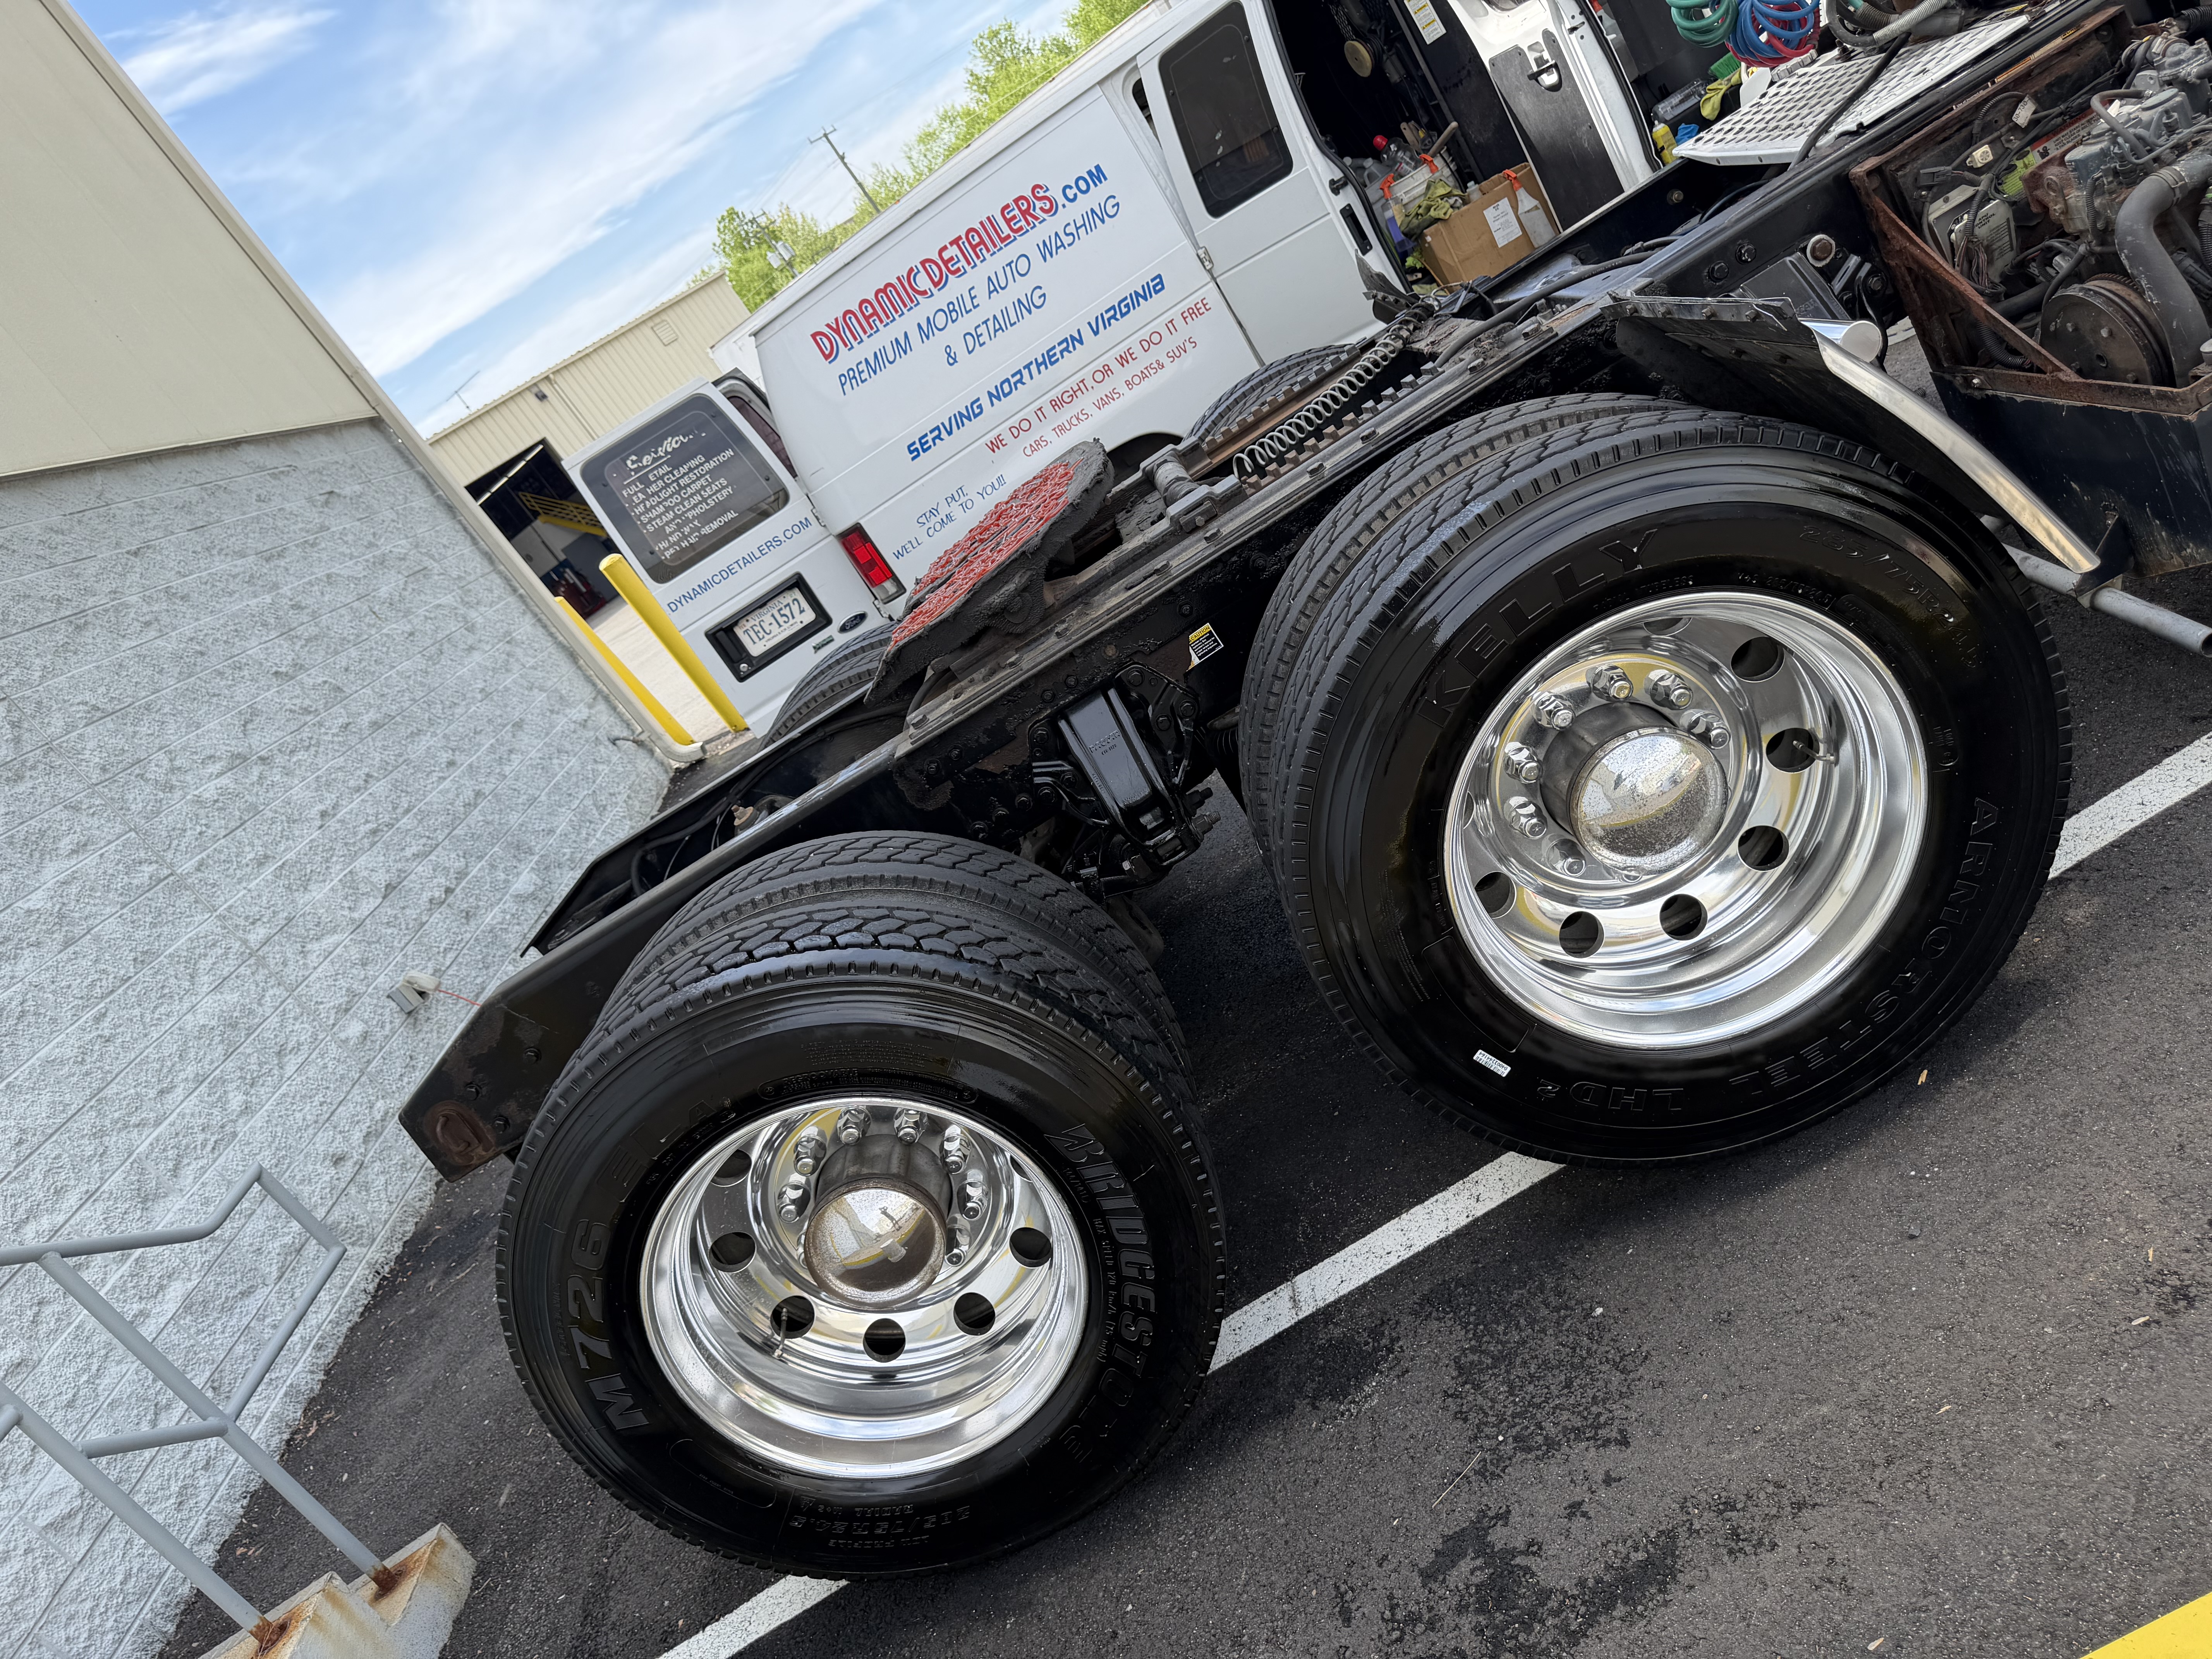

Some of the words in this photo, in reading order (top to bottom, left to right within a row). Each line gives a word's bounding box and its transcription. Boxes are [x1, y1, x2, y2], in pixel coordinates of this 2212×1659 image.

[1975, 213, 1996, 227] ONTROL
[1978, 213, 1988, 222] APU
[1978, 220, 1990, 229] UNIT
[810, 164, 1108, 364] DYNAMICDETAILERS.COM
[838, 331, 913, 396] PREMIUM
[917, 286, 980, 344] MOBILE
[986, 254, 1031, 299] AUTO
[1036, 195, 1120, 263] WASHING
[945, 345, 957, 367] &
[963, 285, 1046, 354] DETAILING
[907, 397, 984, 462] SERVING
[987, 328, 1084, 407] NORTHERN
[1087, 273, 1165, 337] VIRGINIA
[985, 433, 1007, 453] WE
[1009, 418, 1031, 439] DO
[1034, 406, 1050, 423] IT
[1115, 347, 1138, 368] WE
[1139, 331, 1162, 353] DO
[1165, 318, 1178, 336] IT
[1180, 297, 1212, 326] FREE
[1022, 435, 1053, 457] CARS,
[1052, 409, 1093, 438] TRUCKS,
[1092, 387, 1124, 411] VANS,
[1166, 336, 1197, 363] SUV'S
[622, 482, 644, 497] FULL
[647, 464, 672, 481] ETAIL
[634, 481, 665, 505] EAHER
[664, 455, 705, 483] CLEANING
[680, 448, 734, 487] RESTORATION
[680, 474, 712, 497] CARPET
[646, 511, 674, 532] STEAM
[674, 495, 702, 514] CLEAN
[701, 478, 727, 498] SEATS
[682, 486, 733, 520] PHOLSTERY
[701, 510, 739, 536] REMOVAL
[893, 536, 923, 560] WE'LL
[927, 511, 957, 537] COME
[958, 498, 974, 513] TO
[976, 474, 1006, 500] YOU!!
[917, 502, 940, 528] STAY
[945, 485, 968, 507] PUT,
[667, 517, 812, 613] DYNAMICDETAILERS.COM
[743, 598, 805, 645] TEC-1572
[750, 600, 783, 622] VIRGINIA
[1191, 626, 1210, 640] CAUTION
[1416, 528, 1658, 728] KELLY
[1729, 797, 1999, 1095] ARMORSTEEL
[1044, 1123, 1157, 1463] BRIDGESTONE
[567, 1219, 650, 1430] M726
